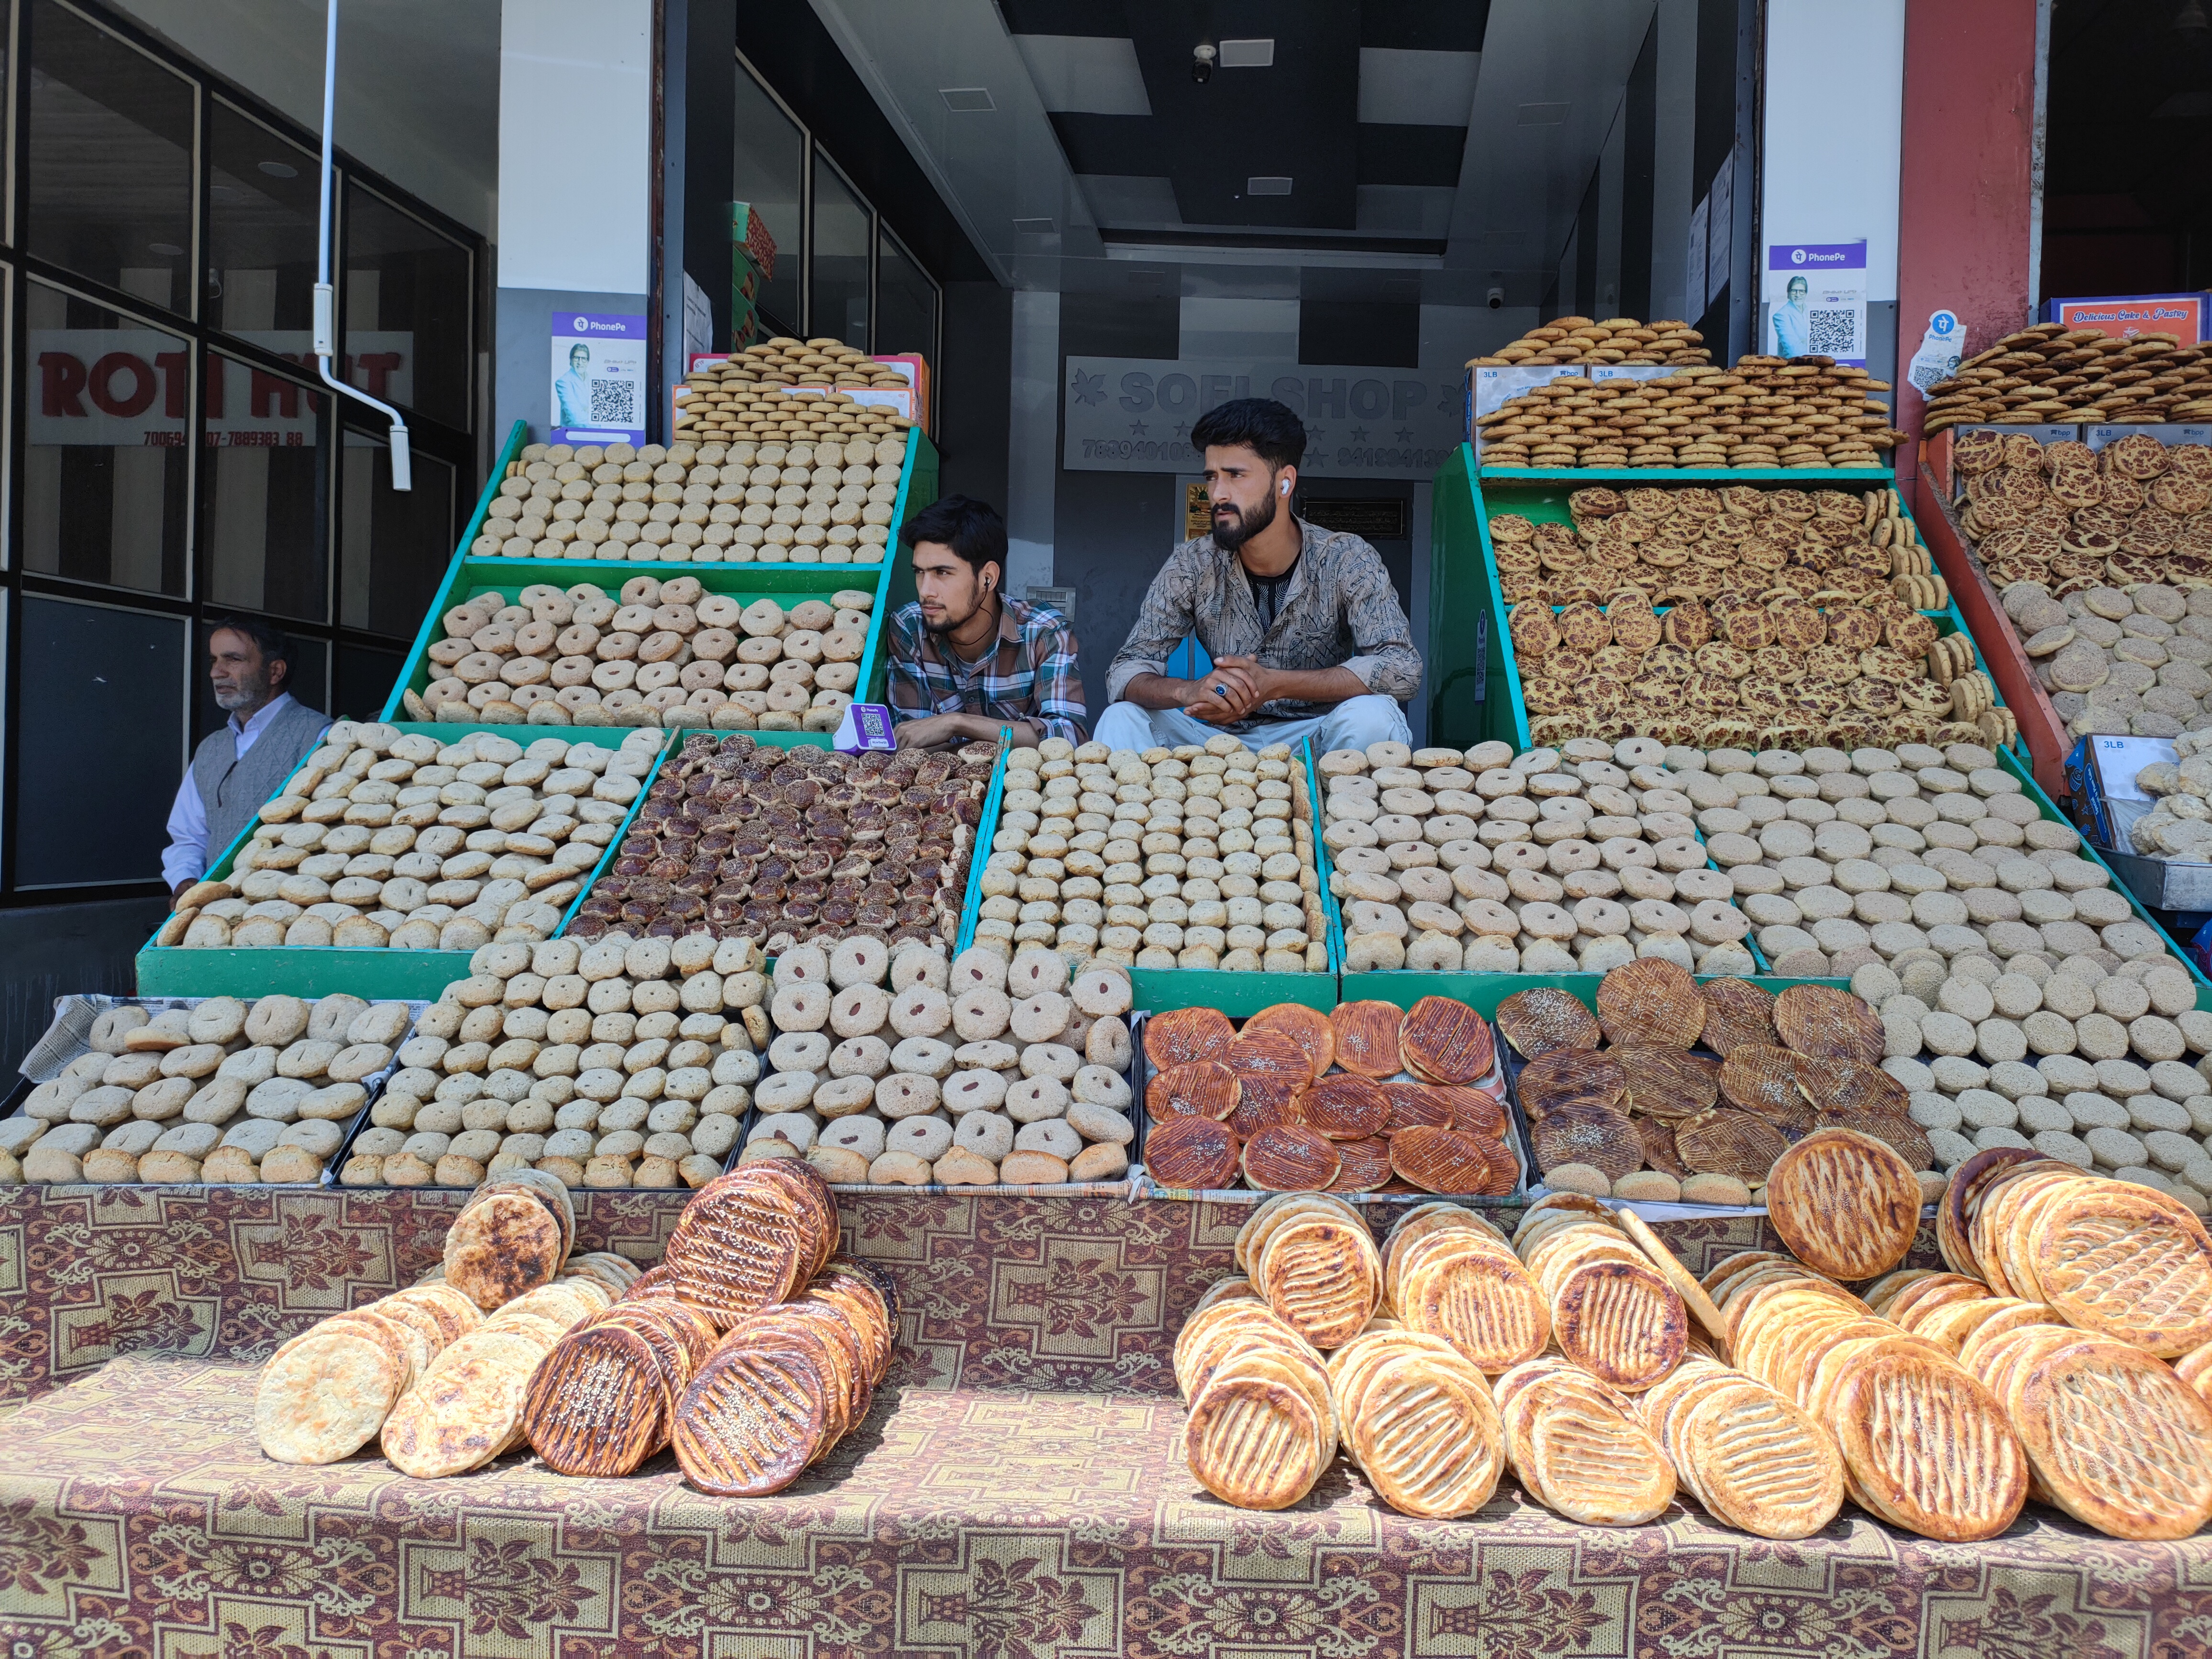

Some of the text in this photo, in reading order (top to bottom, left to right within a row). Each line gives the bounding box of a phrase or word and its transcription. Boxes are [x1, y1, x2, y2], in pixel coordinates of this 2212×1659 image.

[1809, 253, 1845, 262] PhonePe
[2073, 308, 2189, 322] Delicious Cake & Pastry
[590, 321, 626, 332] PhonePe
[1928, 334, 1952, 343] PhonePe
[1270, 376, 1428, 421] SHOP
